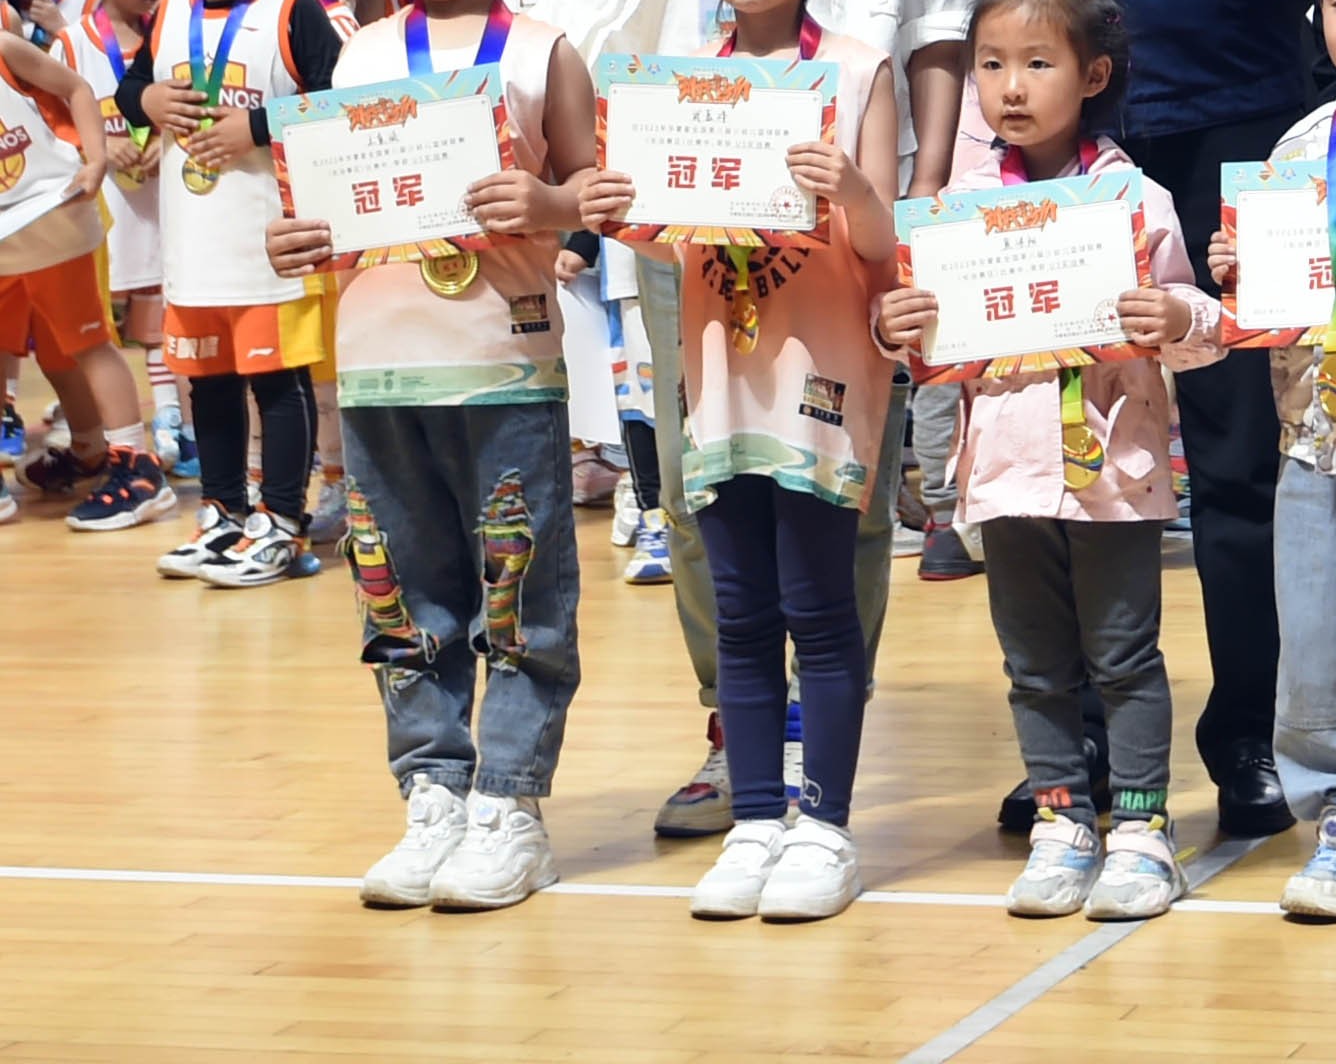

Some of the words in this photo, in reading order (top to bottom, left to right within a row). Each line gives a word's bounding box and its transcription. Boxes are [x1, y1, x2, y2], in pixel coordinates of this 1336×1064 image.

[351, 173, 425, 216] 冠军
[667, 155, 742, 191] 冠军
[983, 279, 1061, 322] 冠军
